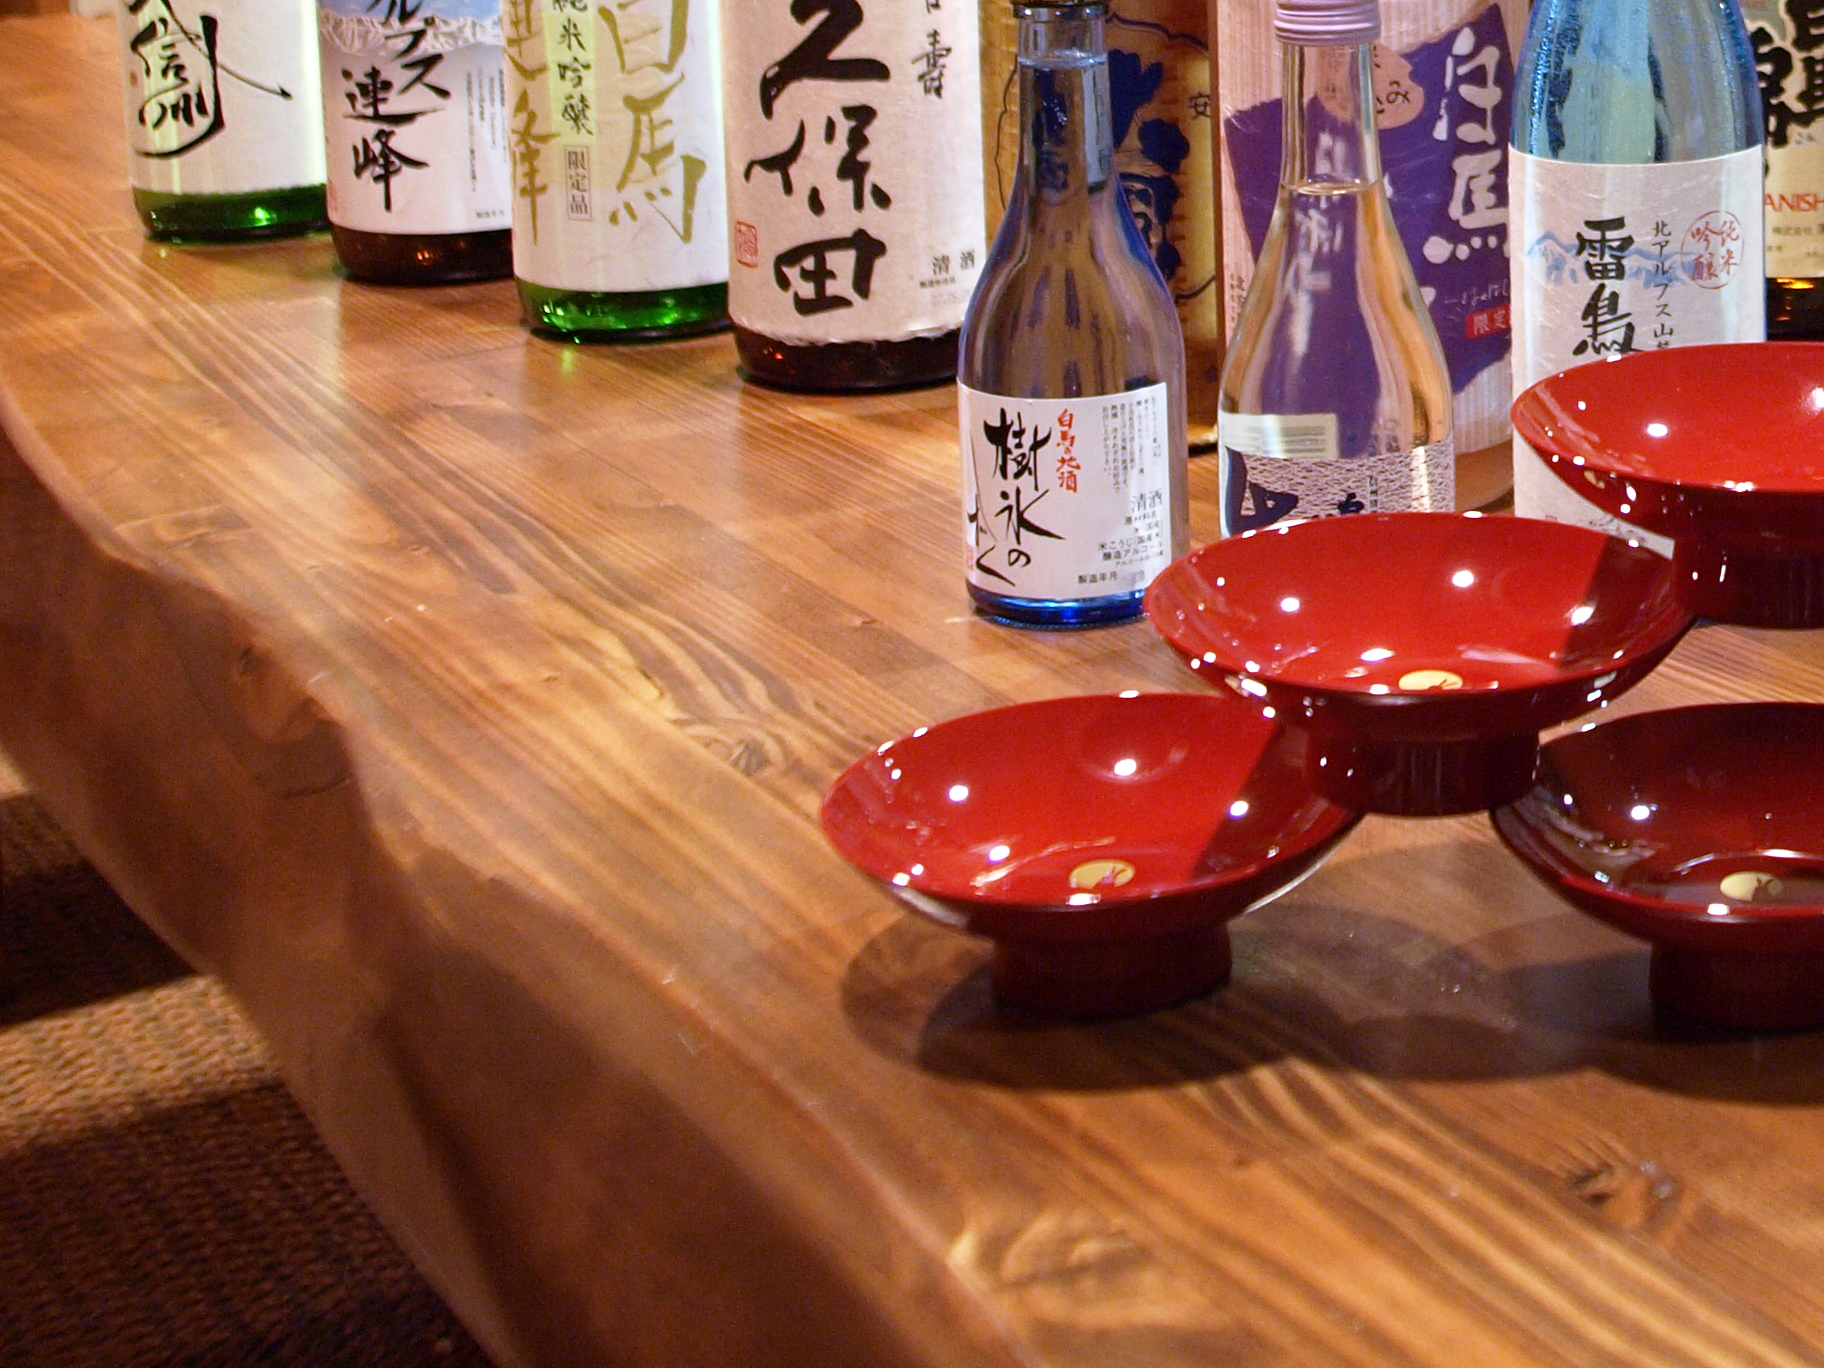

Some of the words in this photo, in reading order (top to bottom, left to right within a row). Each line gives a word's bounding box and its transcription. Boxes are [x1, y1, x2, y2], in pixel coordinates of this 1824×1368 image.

[342, 65, 446, 214] 連峰
[567, 149, 589, 216] 限定品
[1572, 215, 1645, 357] 雷鳥
[983, 407, 1067, 569] 樹氷の
